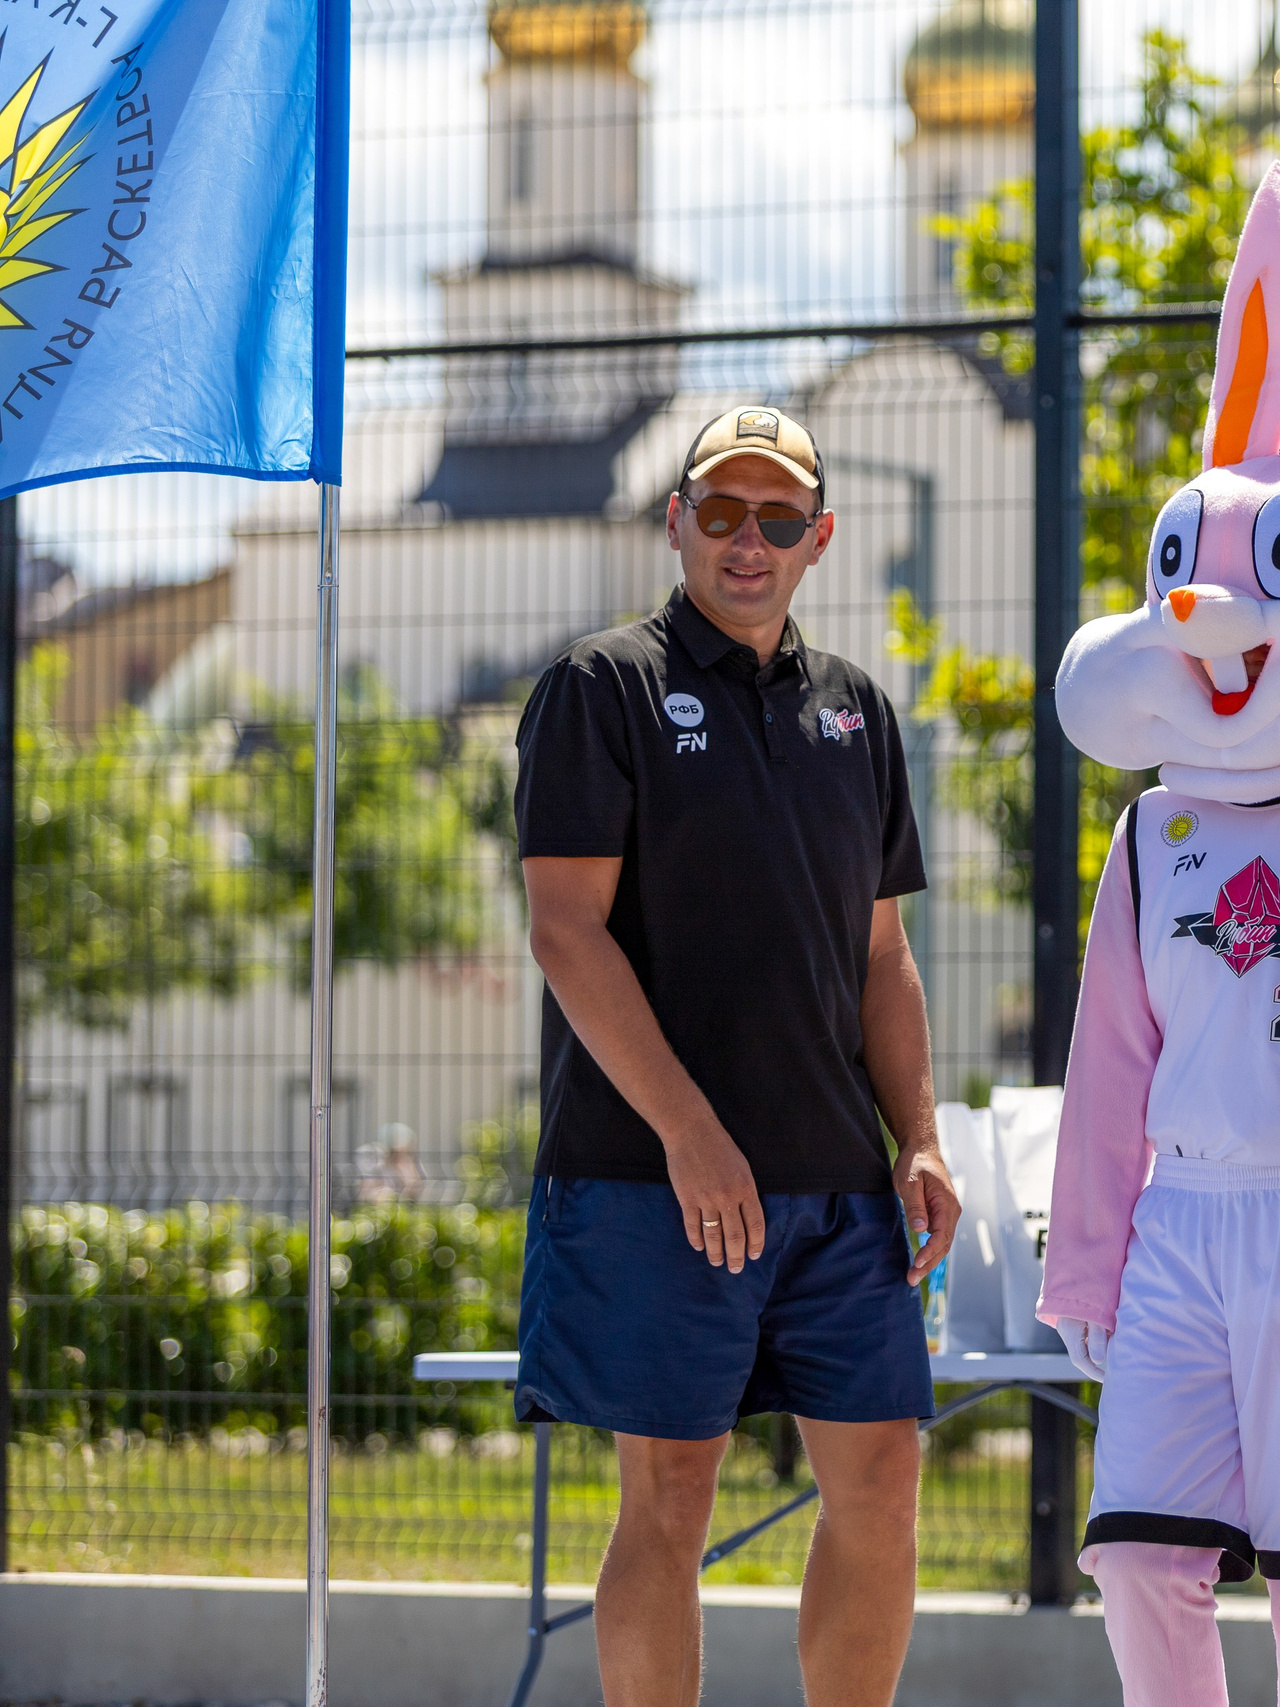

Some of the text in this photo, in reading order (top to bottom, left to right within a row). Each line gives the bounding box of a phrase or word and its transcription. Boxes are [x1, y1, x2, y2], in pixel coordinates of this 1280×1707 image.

[669, 704, 699, 715] РФБ
[818, 708, 865, 741] Рубин
[676, 731, 707, 754] FN
[1215, 916, 1278, 957] Рубин
